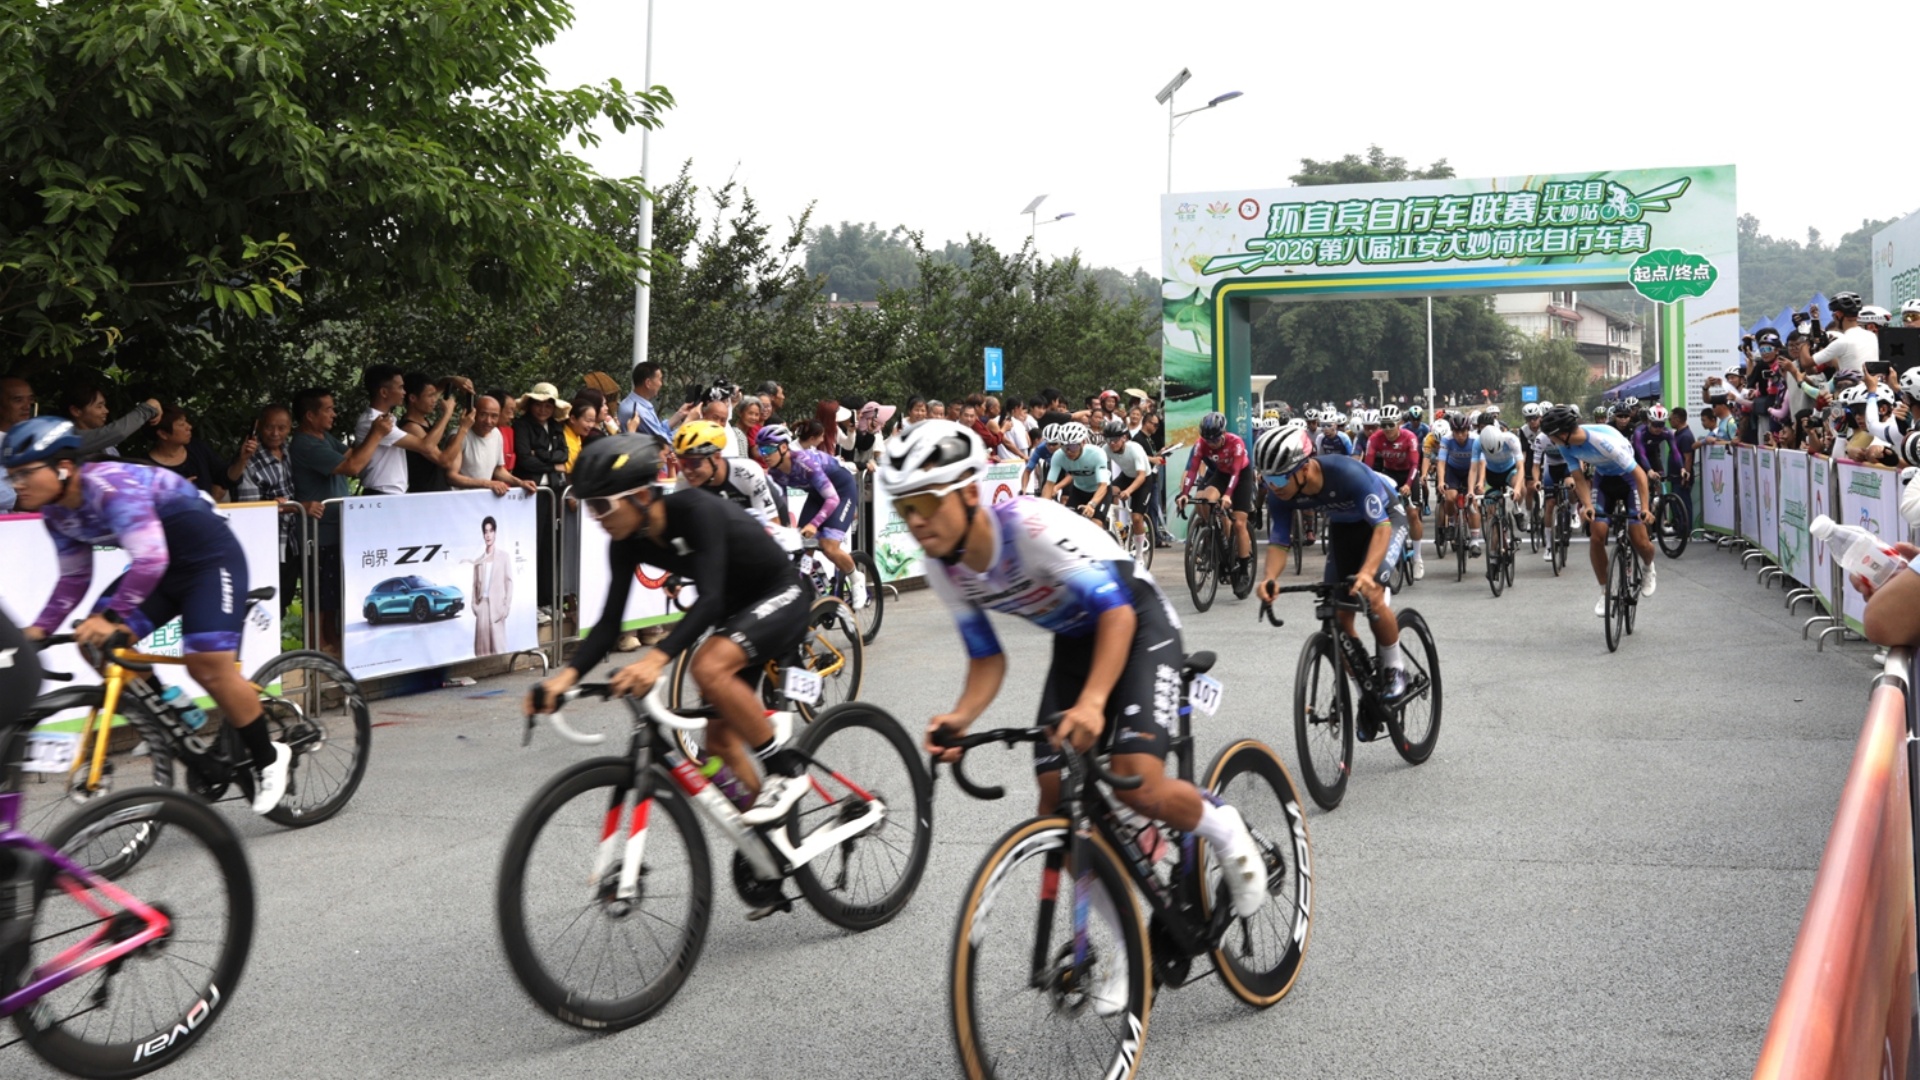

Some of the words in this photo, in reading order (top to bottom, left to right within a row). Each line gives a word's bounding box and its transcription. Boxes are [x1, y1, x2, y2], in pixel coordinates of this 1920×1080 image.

[1544, 181, 1603, 202] 江安县
[1268, 191, 1539, 236] 环宜宾自行车联赛
[1539, 202, 1600, 224] 大妙站
[1633, 263, 1711, 283] 起点/终点
[349, 502, 382, 510] SAIC
[362, 548, 388, 568] 尚界
[394, 544, 443, 565] Z7
[1194, 679, 1219, 708] 107
